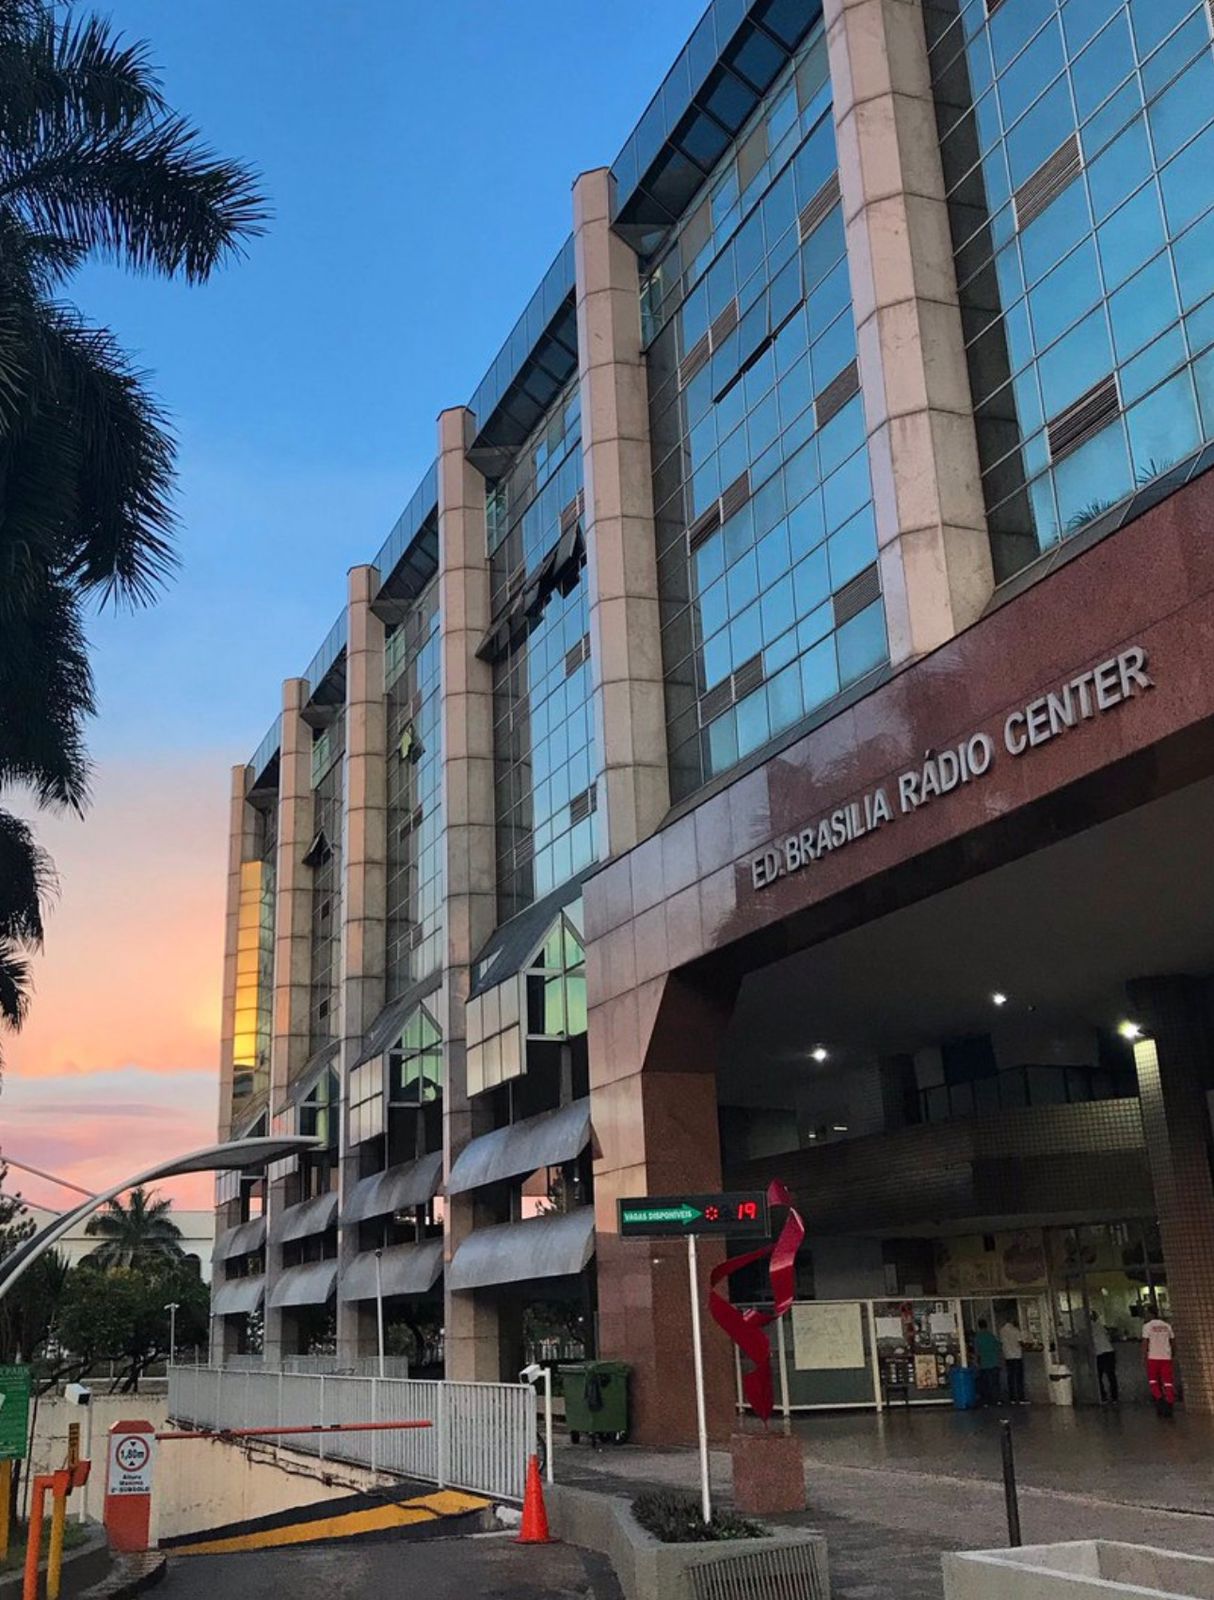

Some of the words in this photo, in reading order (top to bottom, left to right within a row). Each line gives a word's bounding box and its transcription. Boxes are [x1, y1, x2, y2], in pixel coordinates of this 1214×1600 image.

[898, 732, 994, 812] RÁDIO
[1004, 645, 1155, 755] CENTER
[624, 1212, 646, 1221] VAGAS
[737, 1202, 758, 1221] 19
